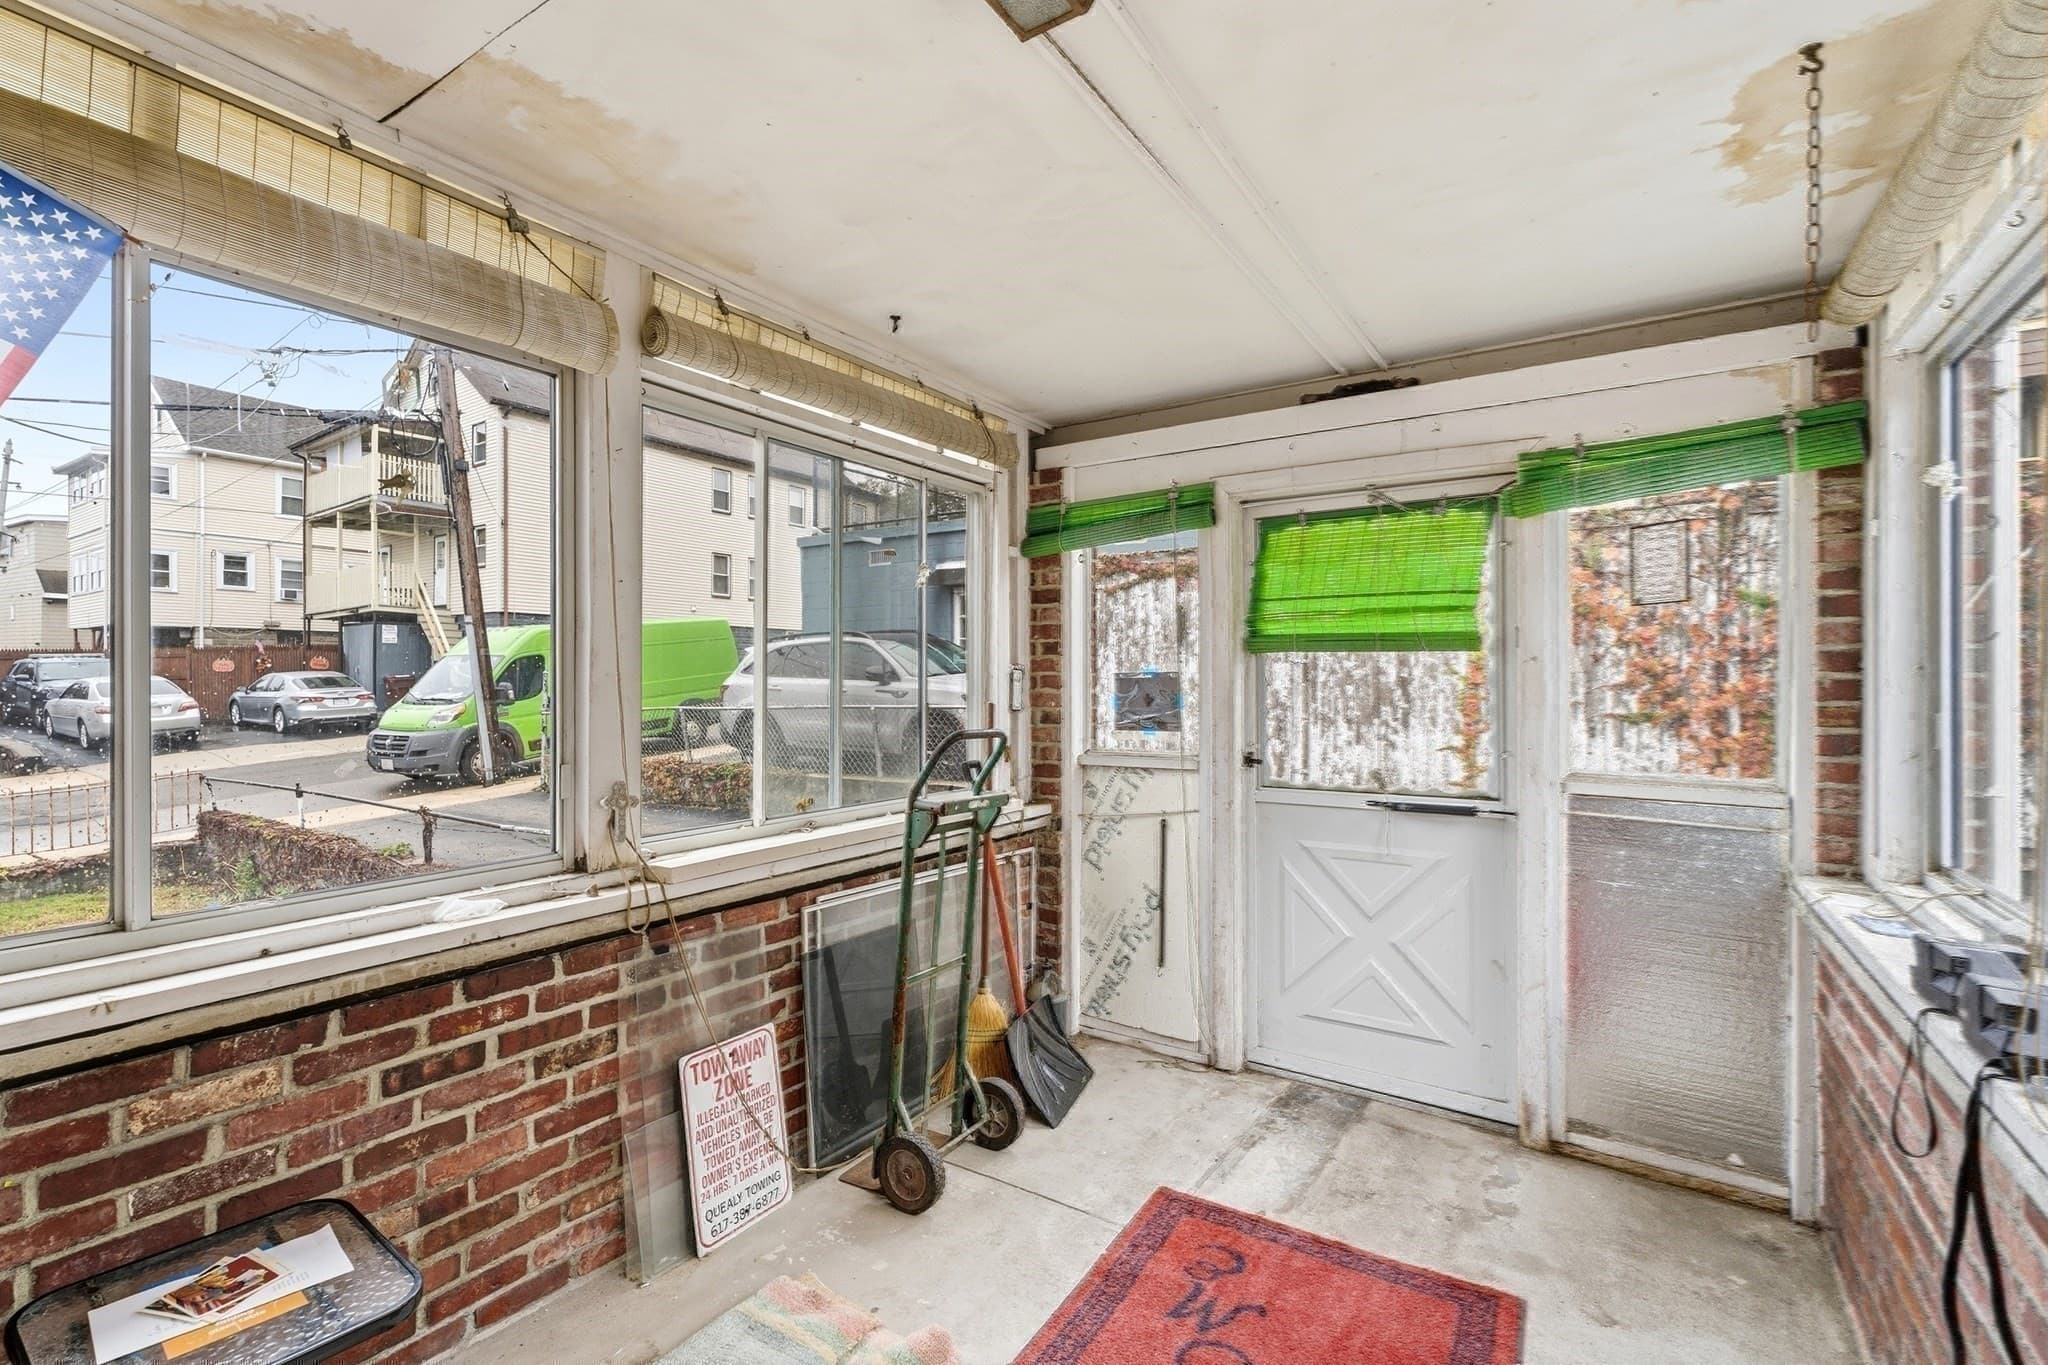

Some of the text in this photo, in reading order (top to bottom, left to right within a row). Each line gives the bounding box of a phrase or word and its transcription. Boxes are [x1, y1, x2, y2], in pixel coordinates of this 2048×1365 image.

[690, 1035, 767, 1086] TOW AWAY
[714, 1066, 753, 1102] ZONE
[696, 1125, 714, 1145] AND
[697, 1097, 738, 1128] ILLEGALLY
[701, 1127, 742, 1157] VEHICLES
[763, 1110, 774, 1125] BE
[701, 1137, 778, 1190] OWNER'S EXPENSE
[704, 1145, 736, 1171] TOWED
[739, 1131, 762, 1154] AWAY
[701, 1190, 711, 1205] 24
[713, 1179, 732, 1198] HRS.
[733, 1174, 739, 1186] 7
[740, 1163, 758, 1183] DAYS
[760, 1160, 766, 1172] A
[705, 1170, 782, 1224] QUEALY TOWING
